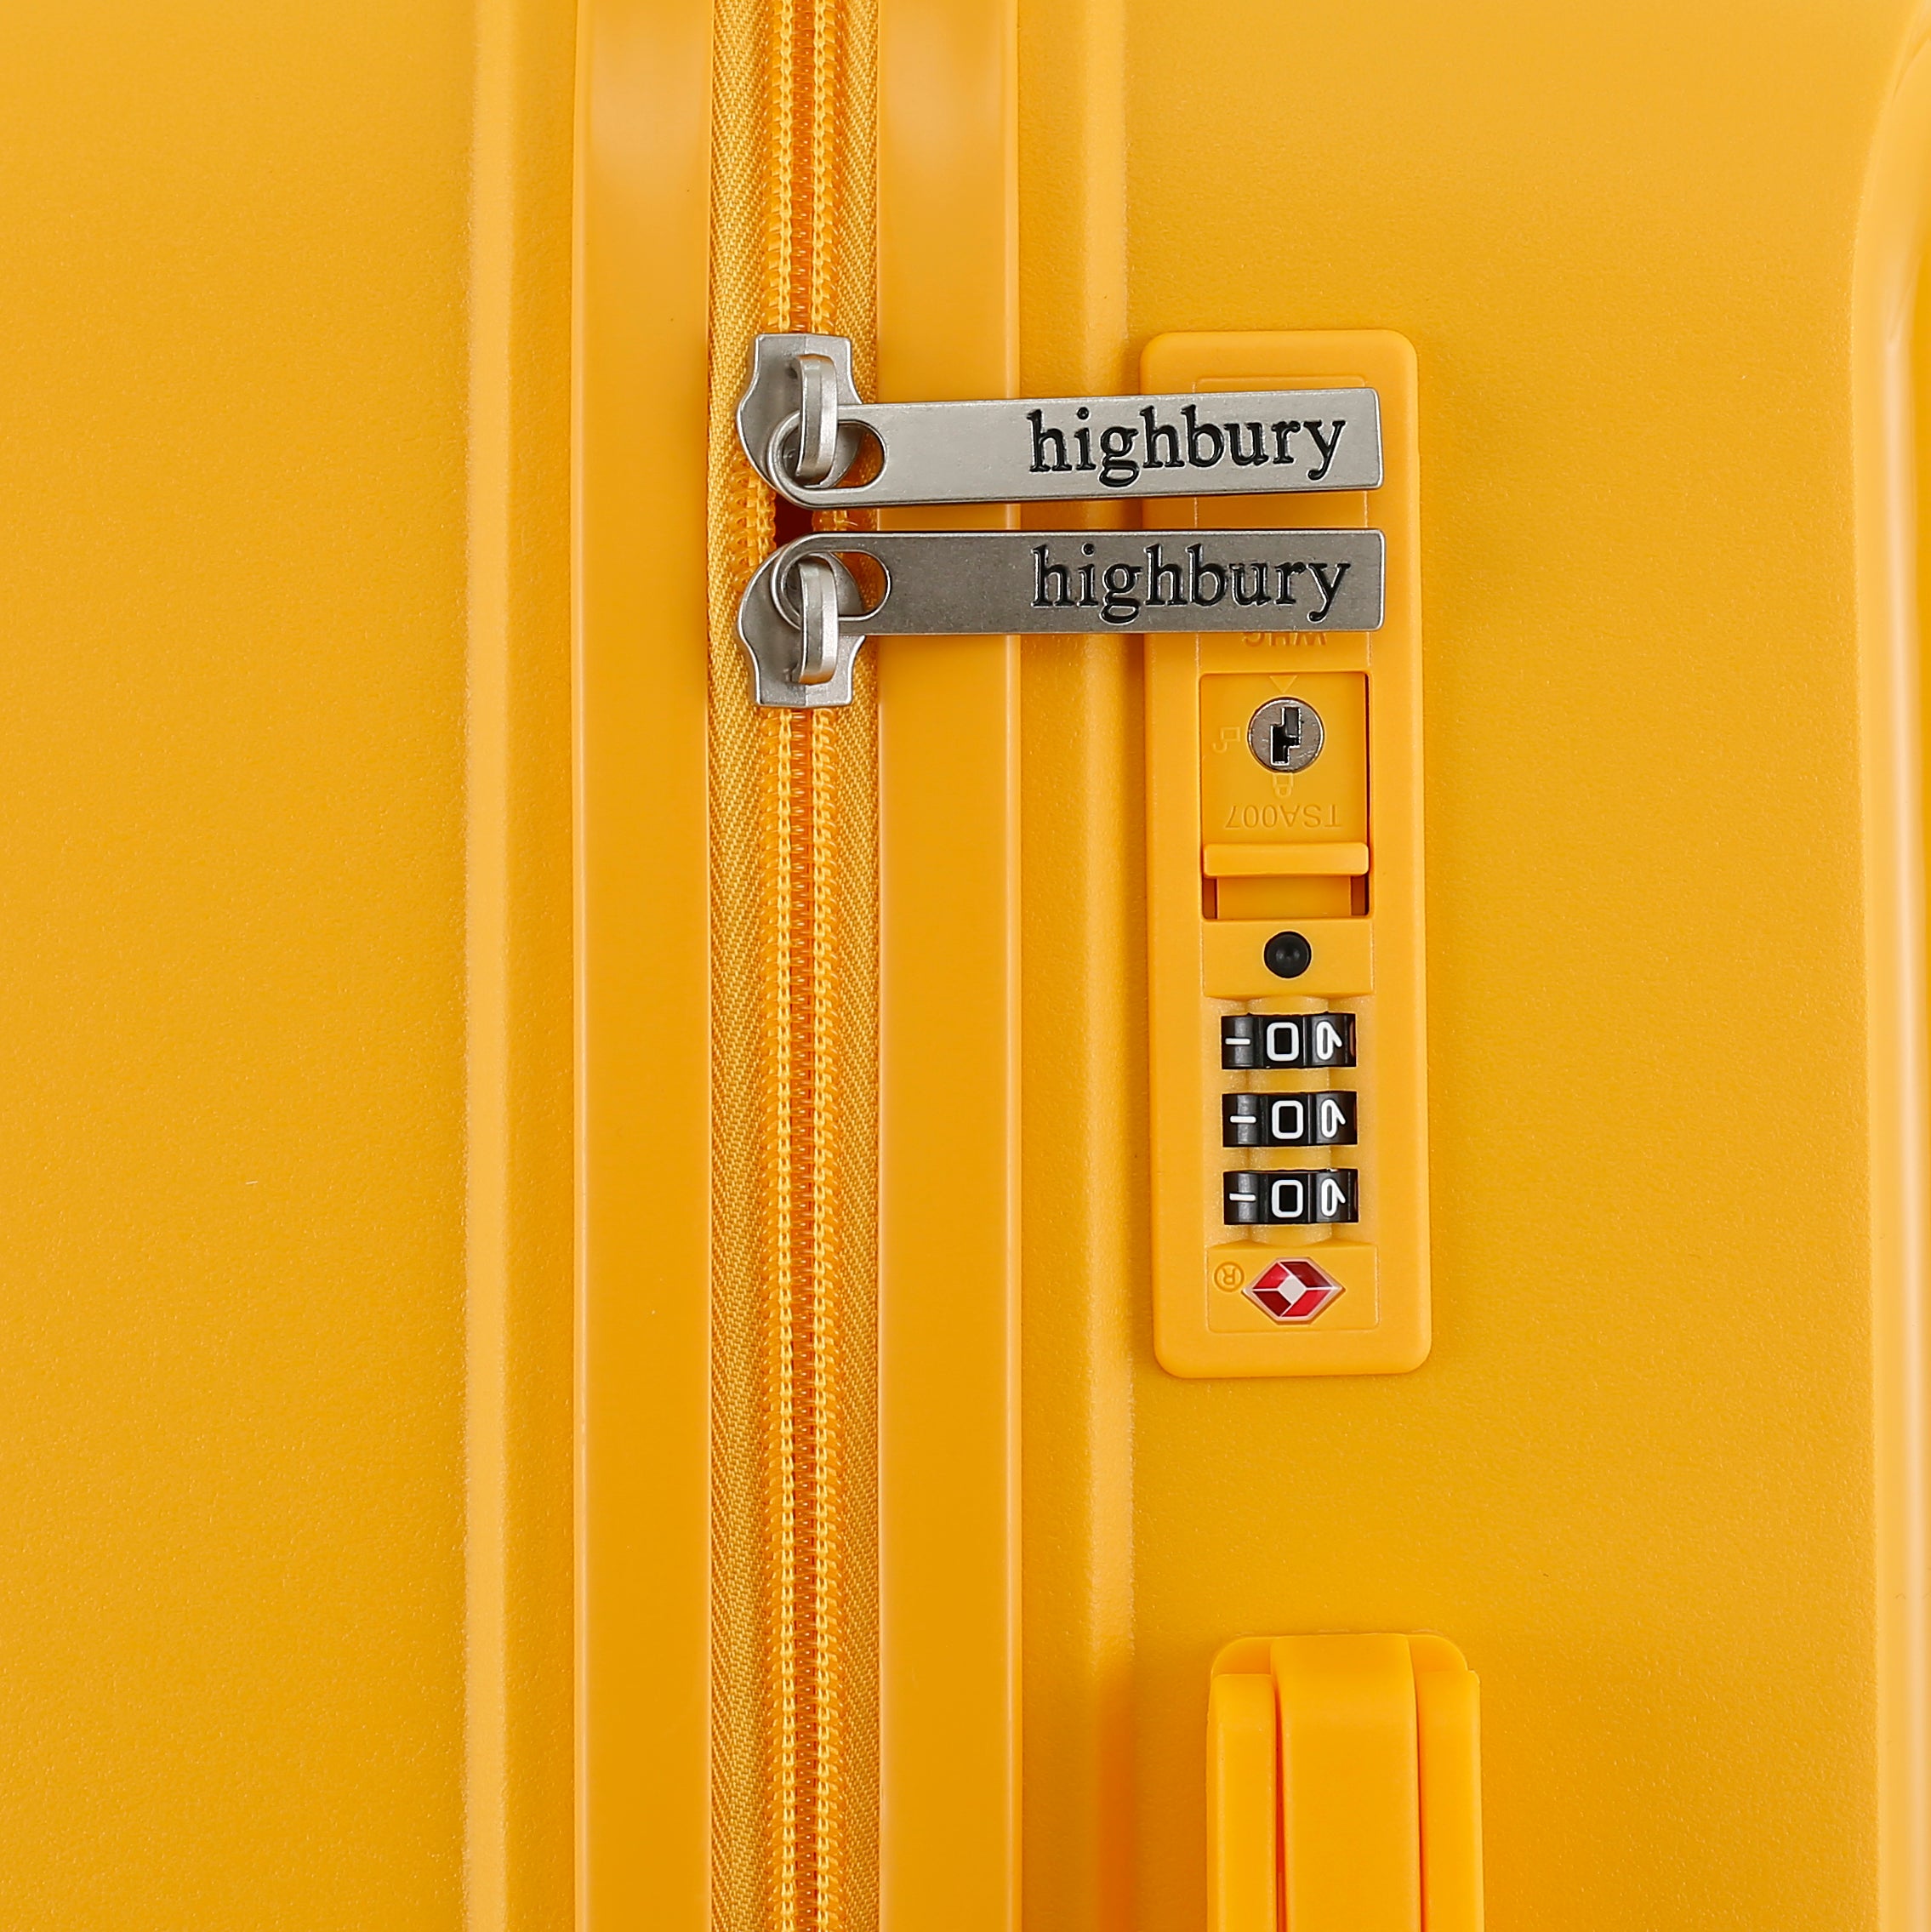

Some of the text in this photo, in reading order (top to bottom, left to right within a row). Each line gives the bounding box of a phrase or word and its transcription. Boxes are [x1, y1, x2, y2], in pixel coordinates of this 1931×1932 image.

[1027, 404, 1347, 487] highbury
[1031, 543, 1351, 624] highbury
[1223, 804, 1341, 830] TSA007
